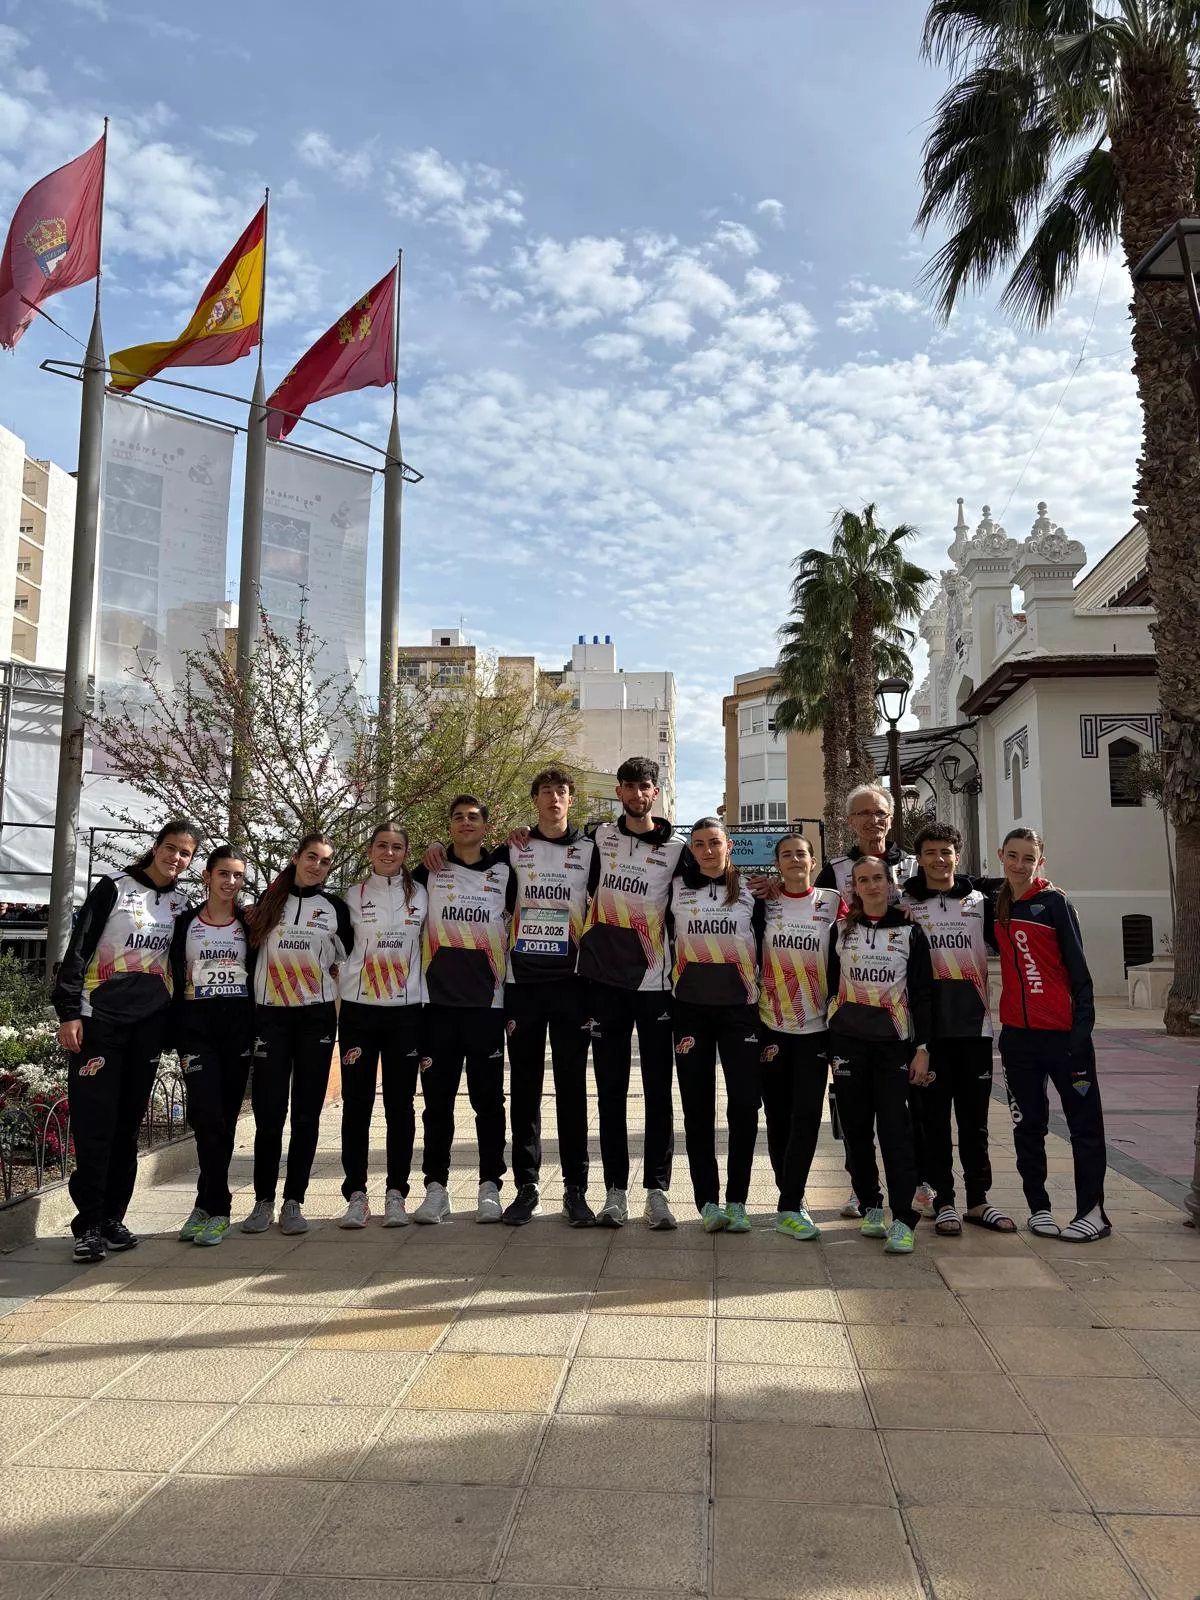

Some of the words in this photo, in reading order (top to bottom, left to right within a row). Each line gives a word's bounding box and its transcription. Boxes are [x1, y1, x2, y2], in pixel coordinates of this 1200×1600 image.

[525, 883, 571, 901] ARAGÓN
[602, 873, 648, 896] ARAGÓN
[441, 906, 490, 923] ARAGÓN
[522, 925, 543, 935] CIEZA
[544, 926, 564, 936] 2026
[687, 917, 737, 935] ARAGÓN
[278, 939, 311, 950] ARAGÓN
[377, 939, 403, 949] ARAGÓN
[522, 940, 561, 952] Joma
[772, 934, 820, 952] ARAGÓN
[928, 931, 972, 949] RAGÓN
[199, 948, 239, 961] ARAGÓN
[207, 971, 236, 985] 295
[849, 966, 896, 983] ARAGÓN
[209, 985, 242, 996] Joma
